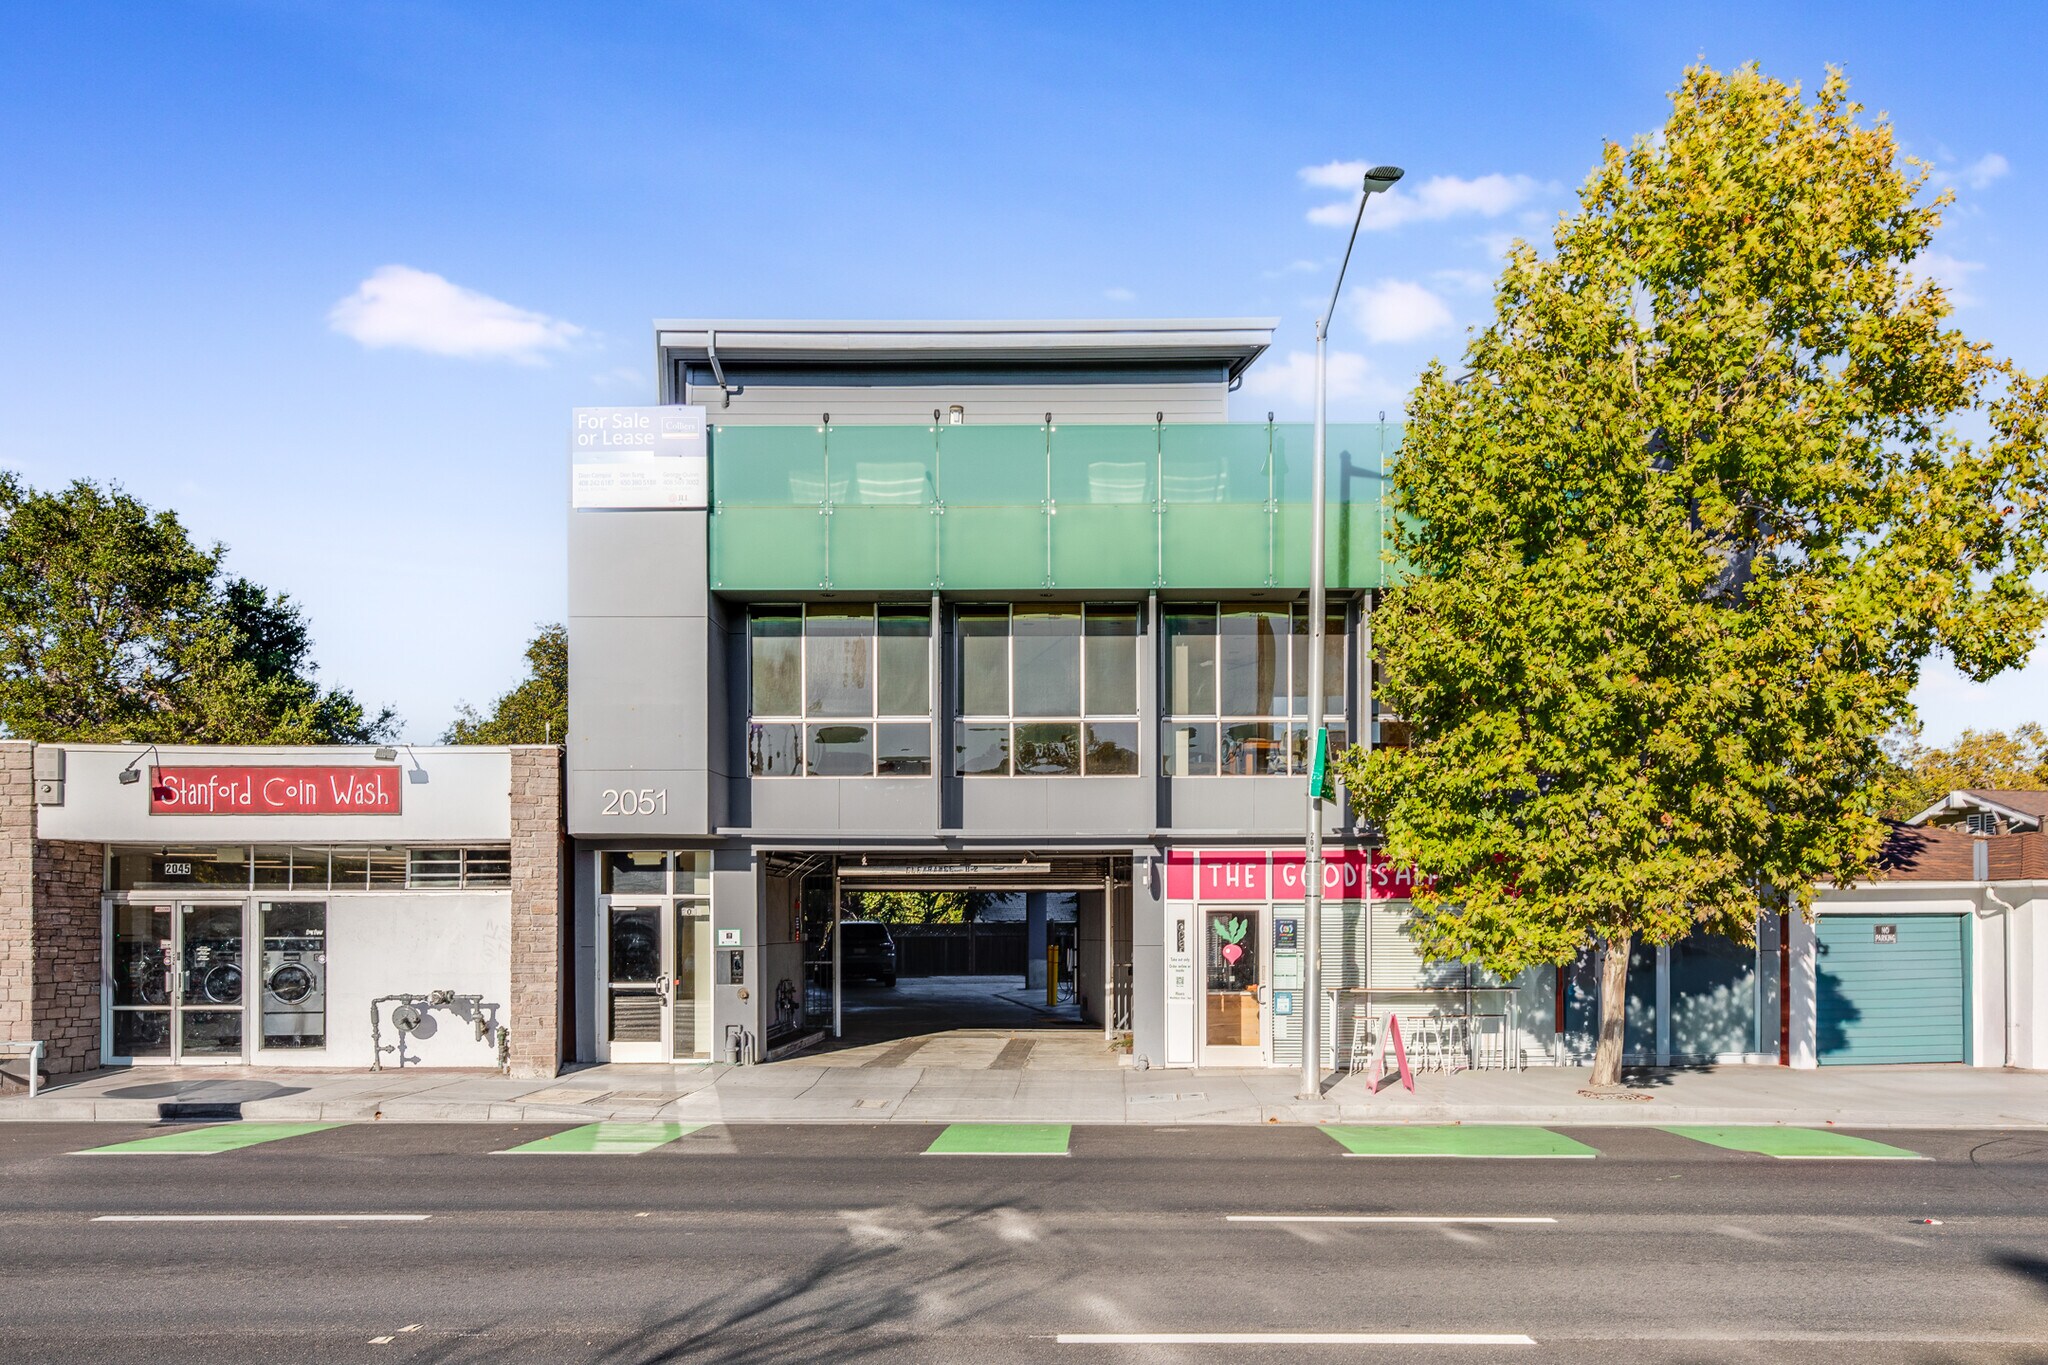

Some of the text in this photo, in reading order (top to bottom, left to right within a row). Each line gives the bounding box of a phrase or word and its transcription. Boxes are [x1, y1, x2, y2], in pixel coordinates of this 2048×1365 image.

[578, 412, 650, 429] For Sale
[666, 421, 695, 430] Colliers
[578, 430, 655, 446] or Lease
[162, 775, 389, 812] Stanford Coin Wash
[602, 789, 668, 815] 2051
[166, 864, 190, 874] 2045
[1207, 863, 1256, 888] THE
[1283, 862, 1357, 887] GOD
[1875, 934, 1896, 942] PARKING
[1881, 926, 1889, 934] NO
